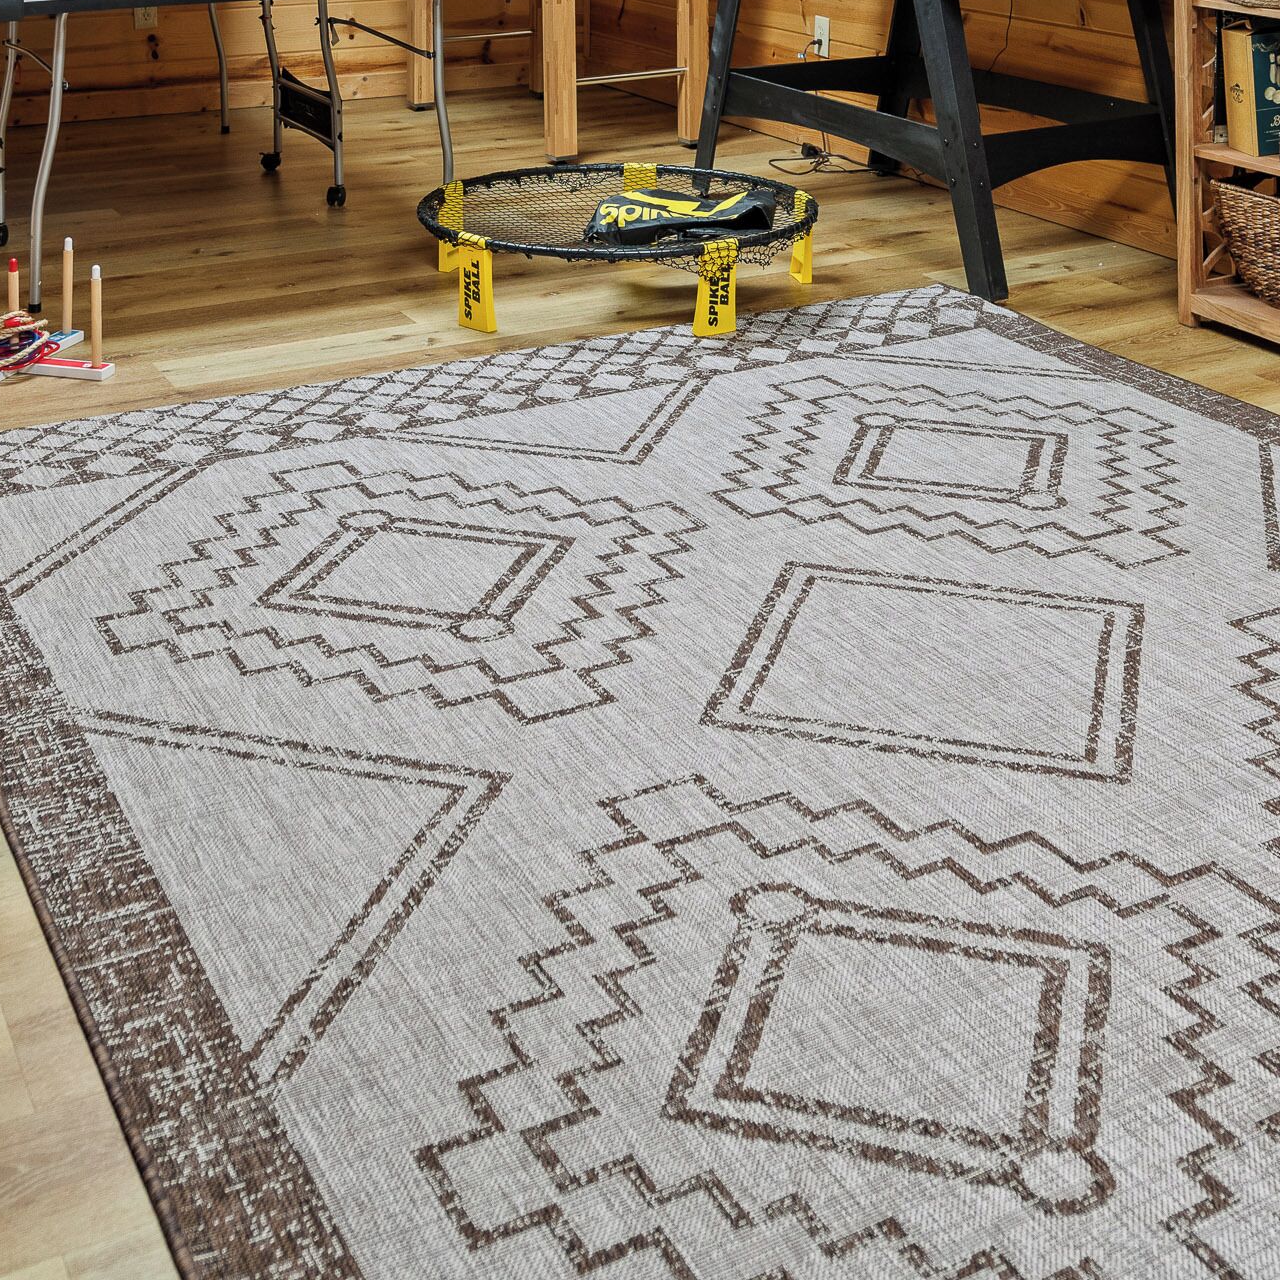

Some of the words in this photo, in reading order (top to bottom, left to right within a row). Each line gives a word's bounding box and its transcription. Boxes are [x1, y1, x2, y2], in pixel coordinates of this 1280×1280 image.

[464, 267, 472, 320] SPIKE
[471, 260, 480, 304] BALL
[708, 275, 720, 327] SPIKE
[720, 263, 731, 305] BALL
